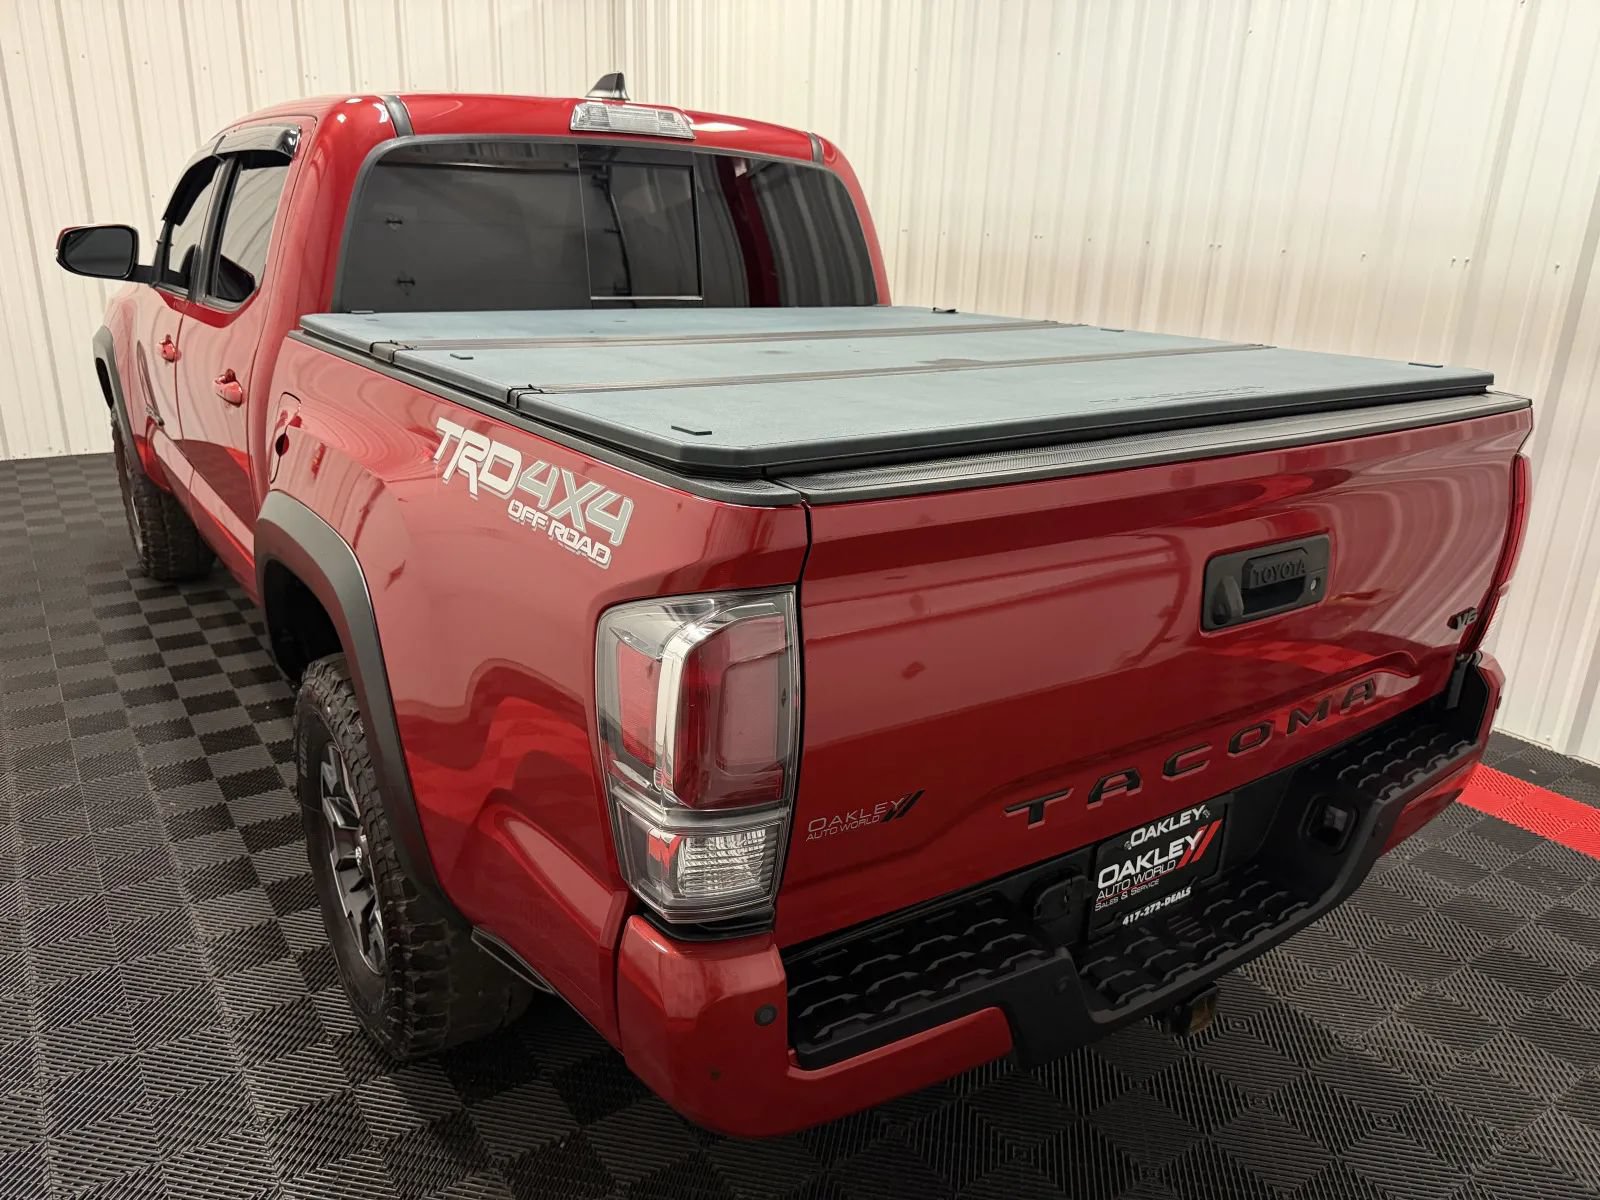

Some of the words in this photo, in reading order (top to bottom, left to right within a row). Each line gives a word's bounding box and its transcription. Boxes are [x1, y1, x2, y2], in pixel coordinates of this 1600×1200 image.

[433, 417, 522, 499] TRD
[517, 460, 634, 546] 4X4
[507, 499, 550, 532] OFF
[546, 519, 614, 570] ROAD
[1252, 559, 1306, 584] TOYOTA
[1003, 676, 1377, 830] TACOMA
[805, 826, 839, 842] AUTO
[840, 815, 880, 832] WORLD
[807, 797, 905, 833] OAKLEY
[1130, 804, 1206, 847] OAKLEY
[1096, 878, 1130, 902] AUTO
[1133, 859, 1177, 886] WORLD
[1097, 830, 1203, 888] OAKLEY
[1120, 892, 1129, 901] &
[1122, 886, 1192, 926] 417-272-DEALS
